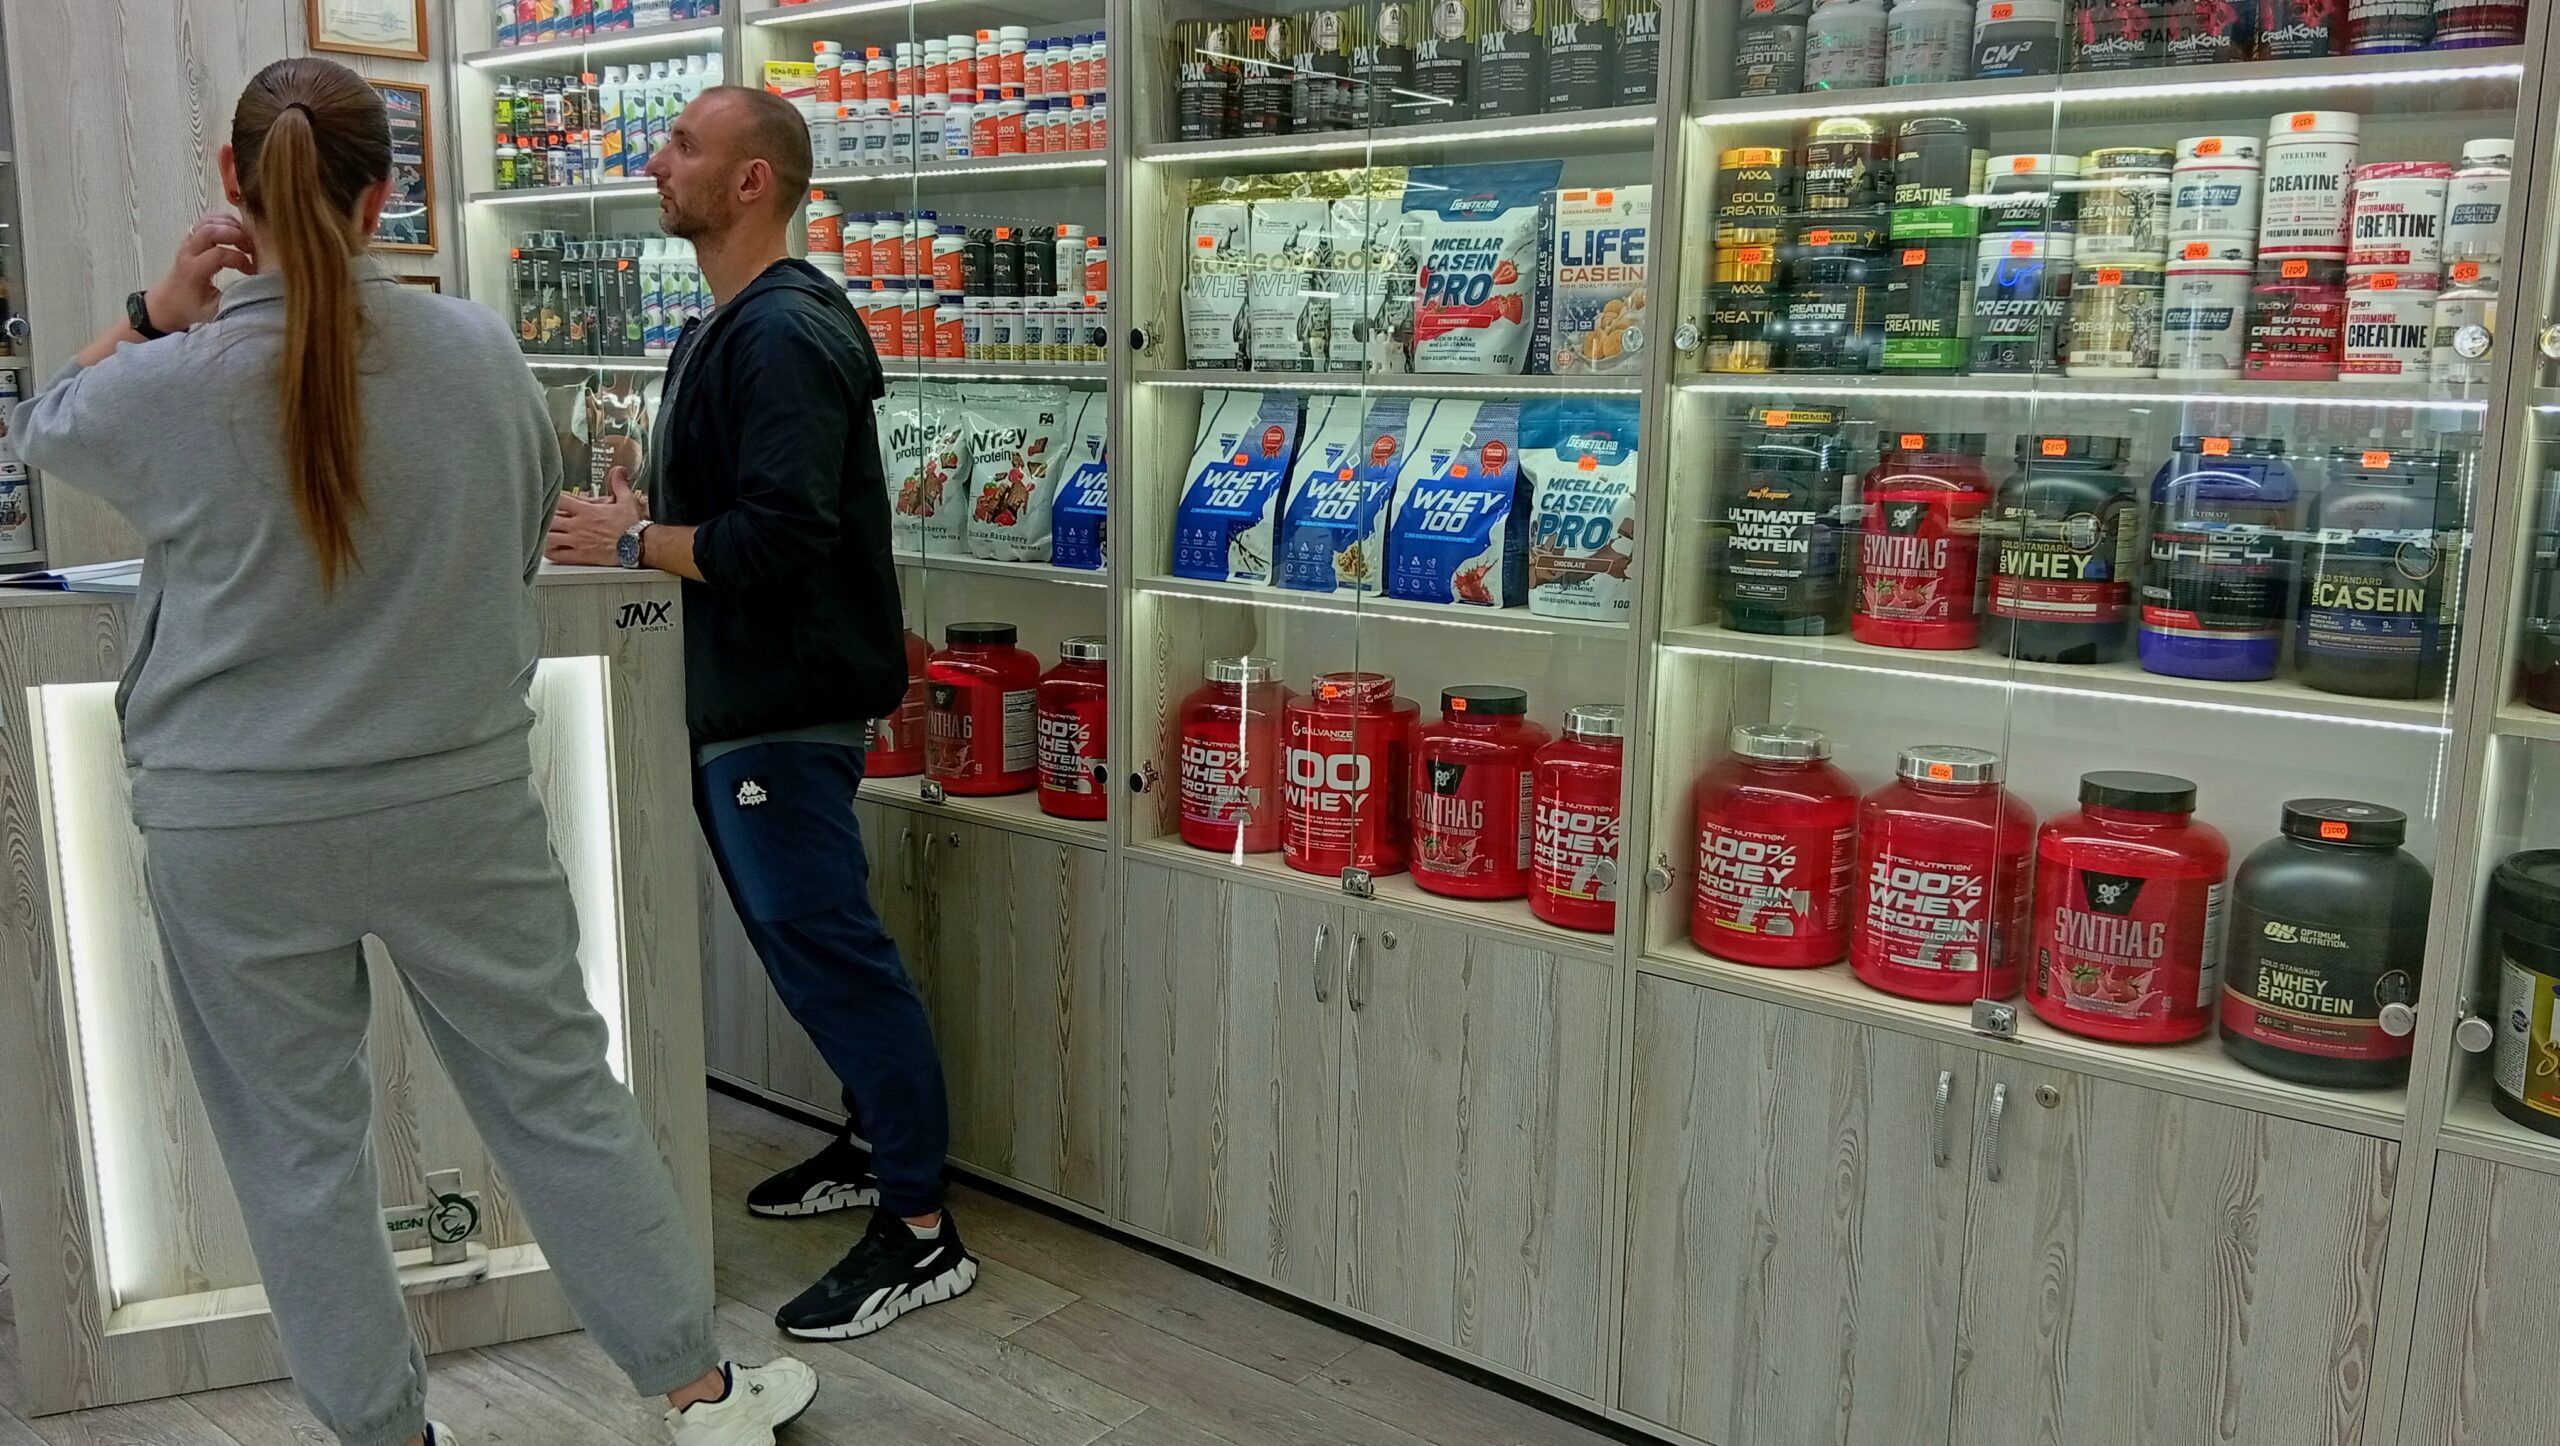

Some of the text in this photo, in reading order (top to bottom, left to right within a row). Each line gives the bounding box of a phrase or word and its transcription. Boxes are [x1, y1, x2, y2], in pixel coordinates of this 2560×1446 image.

[1626, 11, 1657, 35] PAK
[1482, 31, 1506, 53] PAK
[1552, 22, 1579, 44] PAK
[1354, 45, 1379, 65] PAK
[1416, 39, 1438, 61] PAK
[1736, 52, 1795, 65] CREATINE
[1244, 59, 1270, 77] PAK
[1293, 53, 1314, 70] PAK
[1181, 63, 1205, 81] PAK
[2115, 155, 2136, 165] SCAN
[2281, 152, 2328, 160] STEELTIME
[1737, 170, 1773, 180] MXA
[1806, 168, 1853, 180] CREATINE
[2269, 174, 2339, 193] CREATINE
[1732, 192, 1775, 203] GOLD
[1894, 188, 1952, 203] CREATINE
[2180, 188, 2238, 201] CREATINE
[1720, 206, 1787, 217] CREATINE
[2001, 209, 2041, 219] 100%
[2078, 205, 2135, 219] CREATINE
[2357, 203, 2405, 213] PERFORMANCE
[2455, 205, 2497, 215] CREATINE
[2356, 214, 2437, 239] CREATINE
[2453, 213, 2495, 223] CAPSULES
[2266, 229, 2335, 238] PREMIUM QUALITY
[1432, 238, 1504, 251] MICELLAR
[1561, 228, 1645, 266] LIFE
[1426, 253, 1498, 272] CASEIN
[1539, 251, 1548, 287] MEALS
[1560, 267, 1643, 282] CASEIN
[1422, 273, 1494, 307] PRO
[1731, 284, 1765, 294] MXA
[1789, 304, 1847, 312] CREATINE
[1975, 300, 2065, 317] CREATINE
[2166, 310, 2229, 324] CREATINE
[1884, 319, 1941, 332] CREATINE
[1987, 318, 2038, 333] 100%
[2072, 321, 2134, 334] CREATINE
[2349, 314, 2396, 323] PERFORMANCE
[2251, 326, 2337, 337] CREATINE
[2347, 325, 2428, 348] CREATINE
[1039, 413, 1054, 425] FA
[972, 449, 1011, 465] protein
[1203, 469, 1280, 491] WHEY
[1546, 478, 1627, 495] MICELLAR
[1205, 489, 1250, 508] 100
[1307, 478, 1388, 503] WHEY
[1412, 487, 1505, 514] WHEY
[1540, 493, 1617, 515] CASEIN
[1311, 500, 1357, 520] 100
[1728, 508, 1816, 525] ULTIMATE
[2190, 509, 2230, 519] ULTIMATE
[1420, 511, 1469, 533] 100
[1535, 511, 1613, 551] PRO
[1736, 522, 1798, 538] WHEY
[1728, 537, 1808, 554] PROTEIN
[1863, 536, 1948, 570] SYNTHA 6
[2002, 540, 2070, 554] GOLD STANDARD
[1553, 560, 1586, 569] CHOCOLATE
[2006, 552, 2093, 579] WHEY
[2333, 575, 2382, 586] STANDARD
[2318, 583, 2425, 613] CASEIN
[615, 600, 672, 629] JNX
[963, 715, 973, 739] 6
[1301, 727, 1354, 738] GALVANIZE
[1181, 744, 1249, 769] 100%
[1181, 761, 1249, 784] WHEY
[1285, 746, 1371, 791] 100
[1181, 777, 1249, 796] PROTEIN
[1285, 785, 1370, 813] WHEY
[1566, 803, 1614, 812] NUTRITION
[1415, 790, 1483, 828] SYNTHA 6
[1536, 823, 1619, 853] WHEY
[1734, 829, 1787, 842] NUTRITION
[1700, 830, 1797, 866] 100%
[1700, 851, 1793, 885] WHEY
[1915, 860, 1974, 872] NUTRITION
[1699, 870, 1793, 899] PROTEIN
[1870, 861, 1983, 897] 100%
[1698, 883, 1792, 909] PROFESSIONAL
[1869, 883, 1982, 917] WHEY
[1867, 904, 1980, 933] PROTEIN
[1866, 918, 1979, 943] PROFESSIONAL
[2054, 906, 2166, 958] SYNTHA 6
[2300, 928, 2341, 941] OPTIMUM
[2260, 958, 2321, 977] GOLD STANDARD
[2272, 970, 2328, 996] WHEY
[2270, 989, 2354, 1015] PROTEIN
